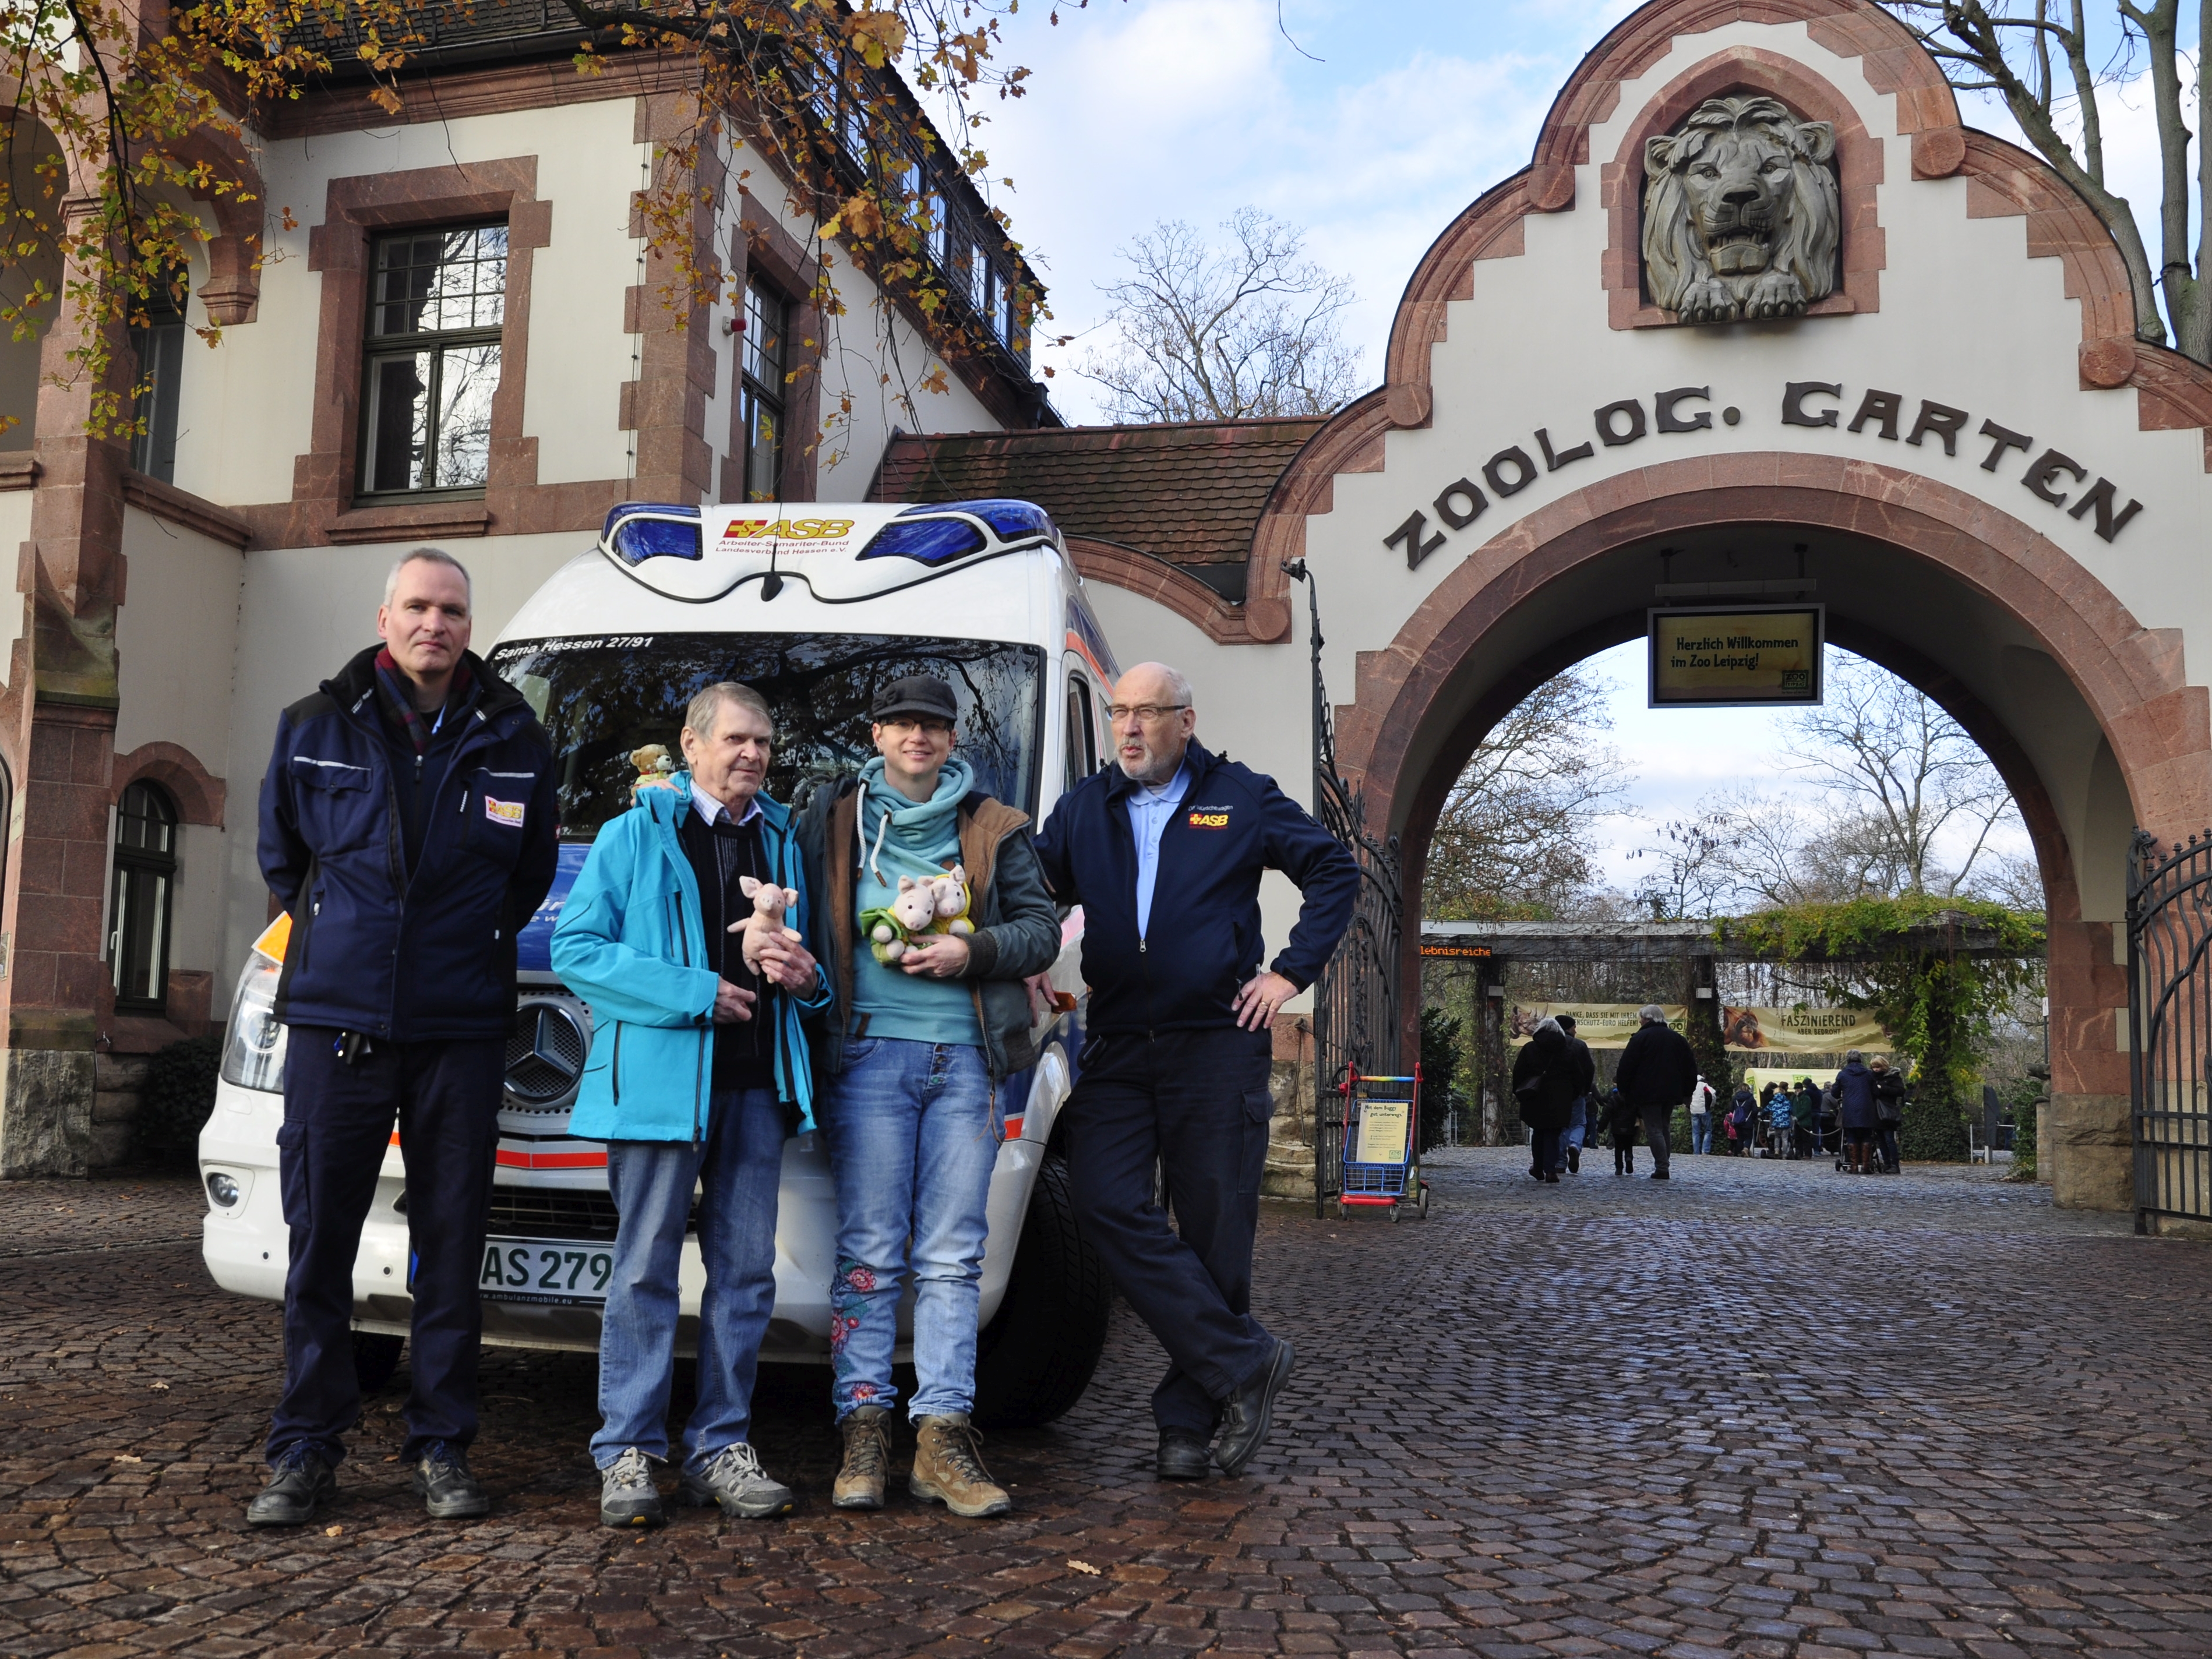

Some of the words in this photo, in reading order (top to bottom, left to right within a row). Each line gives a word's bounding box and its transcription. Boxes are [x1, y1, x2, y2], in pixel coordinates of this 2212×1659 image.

[1382, 385, 1741, 571] ZOOLOG.
[1781, 381, 2144, 543] GARTEN
[749, 518, 855, 539] ASB
[495, 645, 540, 659] Sama
[541, 640, 604, 653] Hessen
[605, 636, 654, 648] 27/91
[1677, 637, 1724, 651] Herzlich
[1727, 636, 1798, 649] Willkommen
[1671, 656, 1687, 668] im
[1689, 655, 1711, 668] Zoo
[1714, 653, 1759, 670] Leipzig!
[496, 804, 522, 818] ASB
[1199, 814, 1229, 827] ASB
[1781, 1015, 1856, 1027] FASZINIEREND
[481, 1247, 530, 1287] AS
[538, 1251, 612, 1291] 279
